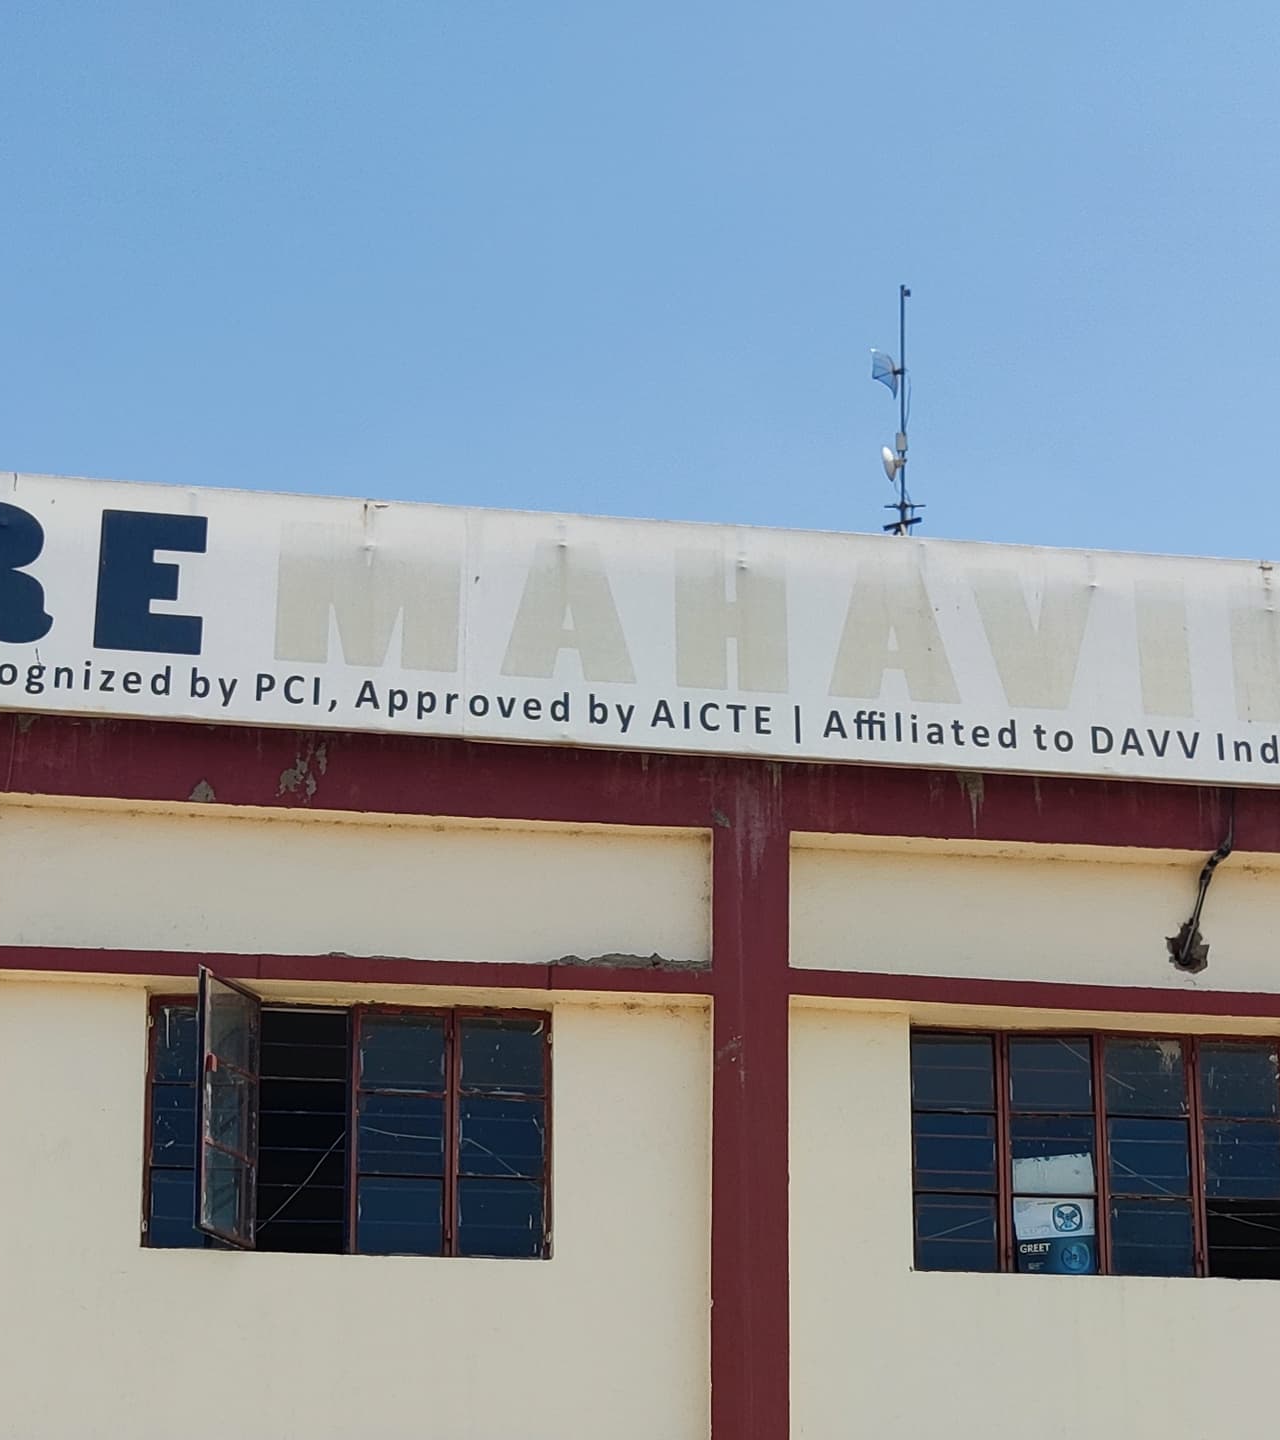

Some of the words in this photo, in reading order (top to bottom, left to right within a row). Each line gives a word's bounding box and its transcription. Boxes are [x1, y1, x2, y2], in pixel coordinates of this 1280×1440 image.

[190, 666, 238, 707] by
[255, 673, 337, 713] PCI,
[354, 680, 570, 723] Approved
[589, 693, 635, 733] by
[650, 699, 772, 735] AICTE
[823, 710, 1017, 749] Affiliated
[1033, 724, 1074, 753] to
[1090, 726, 1200, 759] DAVV
[1020, 1243, 1051, 1253] GREET
